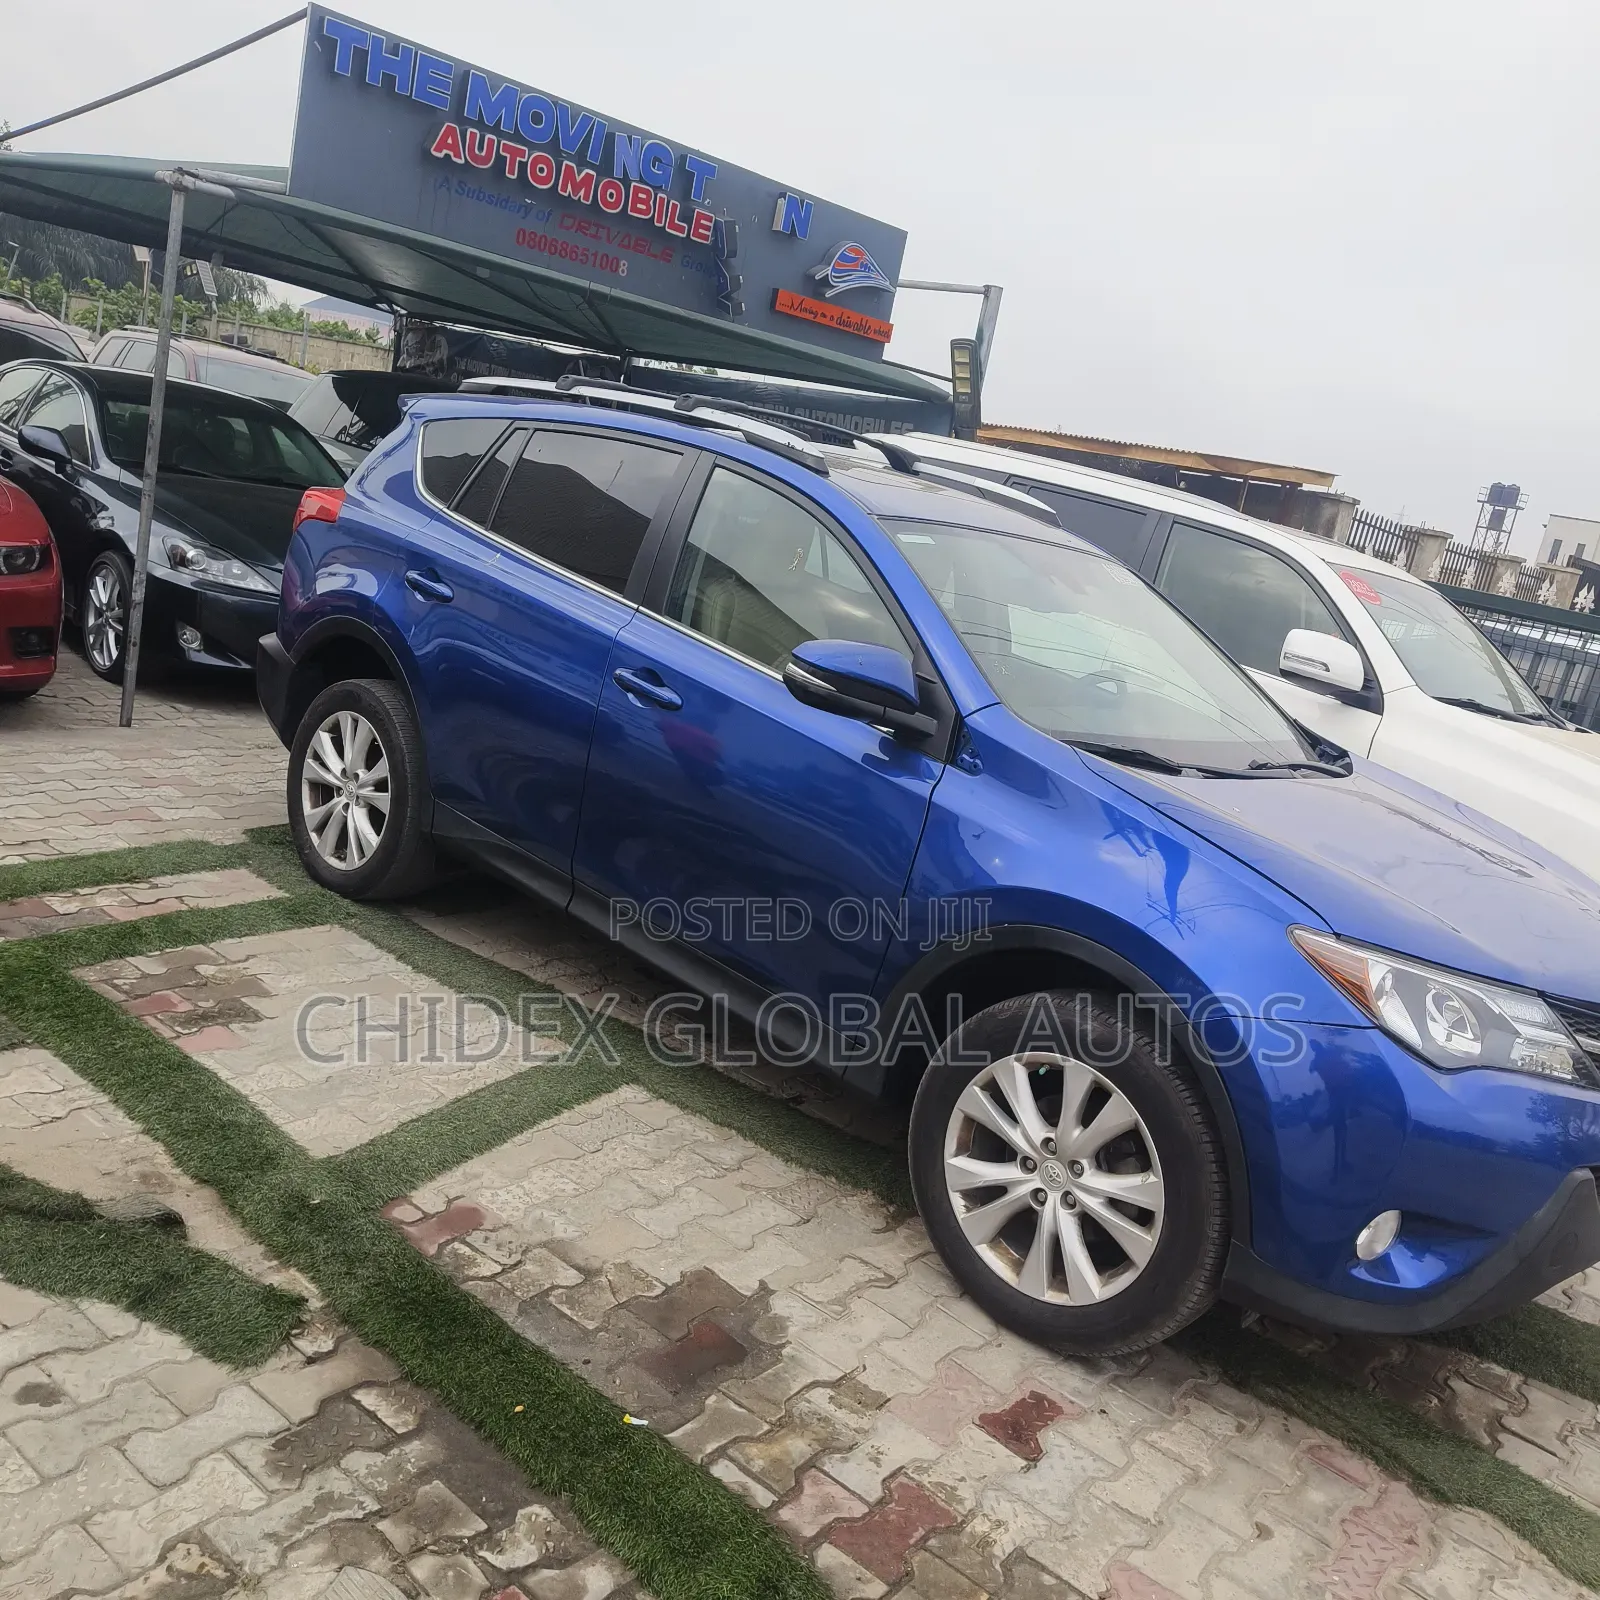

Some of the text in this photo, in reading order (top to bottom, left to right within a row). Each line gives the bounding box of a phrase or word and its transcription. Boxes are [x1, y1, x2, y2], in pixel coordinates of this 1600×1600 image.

[323, 16, 454, 112] THE
[463, 69, 675, 191] MOVING
[430, 122, 716, 244] AUTOMOBILE
[455, 180, 534, 219] Subsidary
[536, 207, 554, 223] of
[515, 228, 628, 277] 08068651008
[836, 312, 872, 335] drivable
